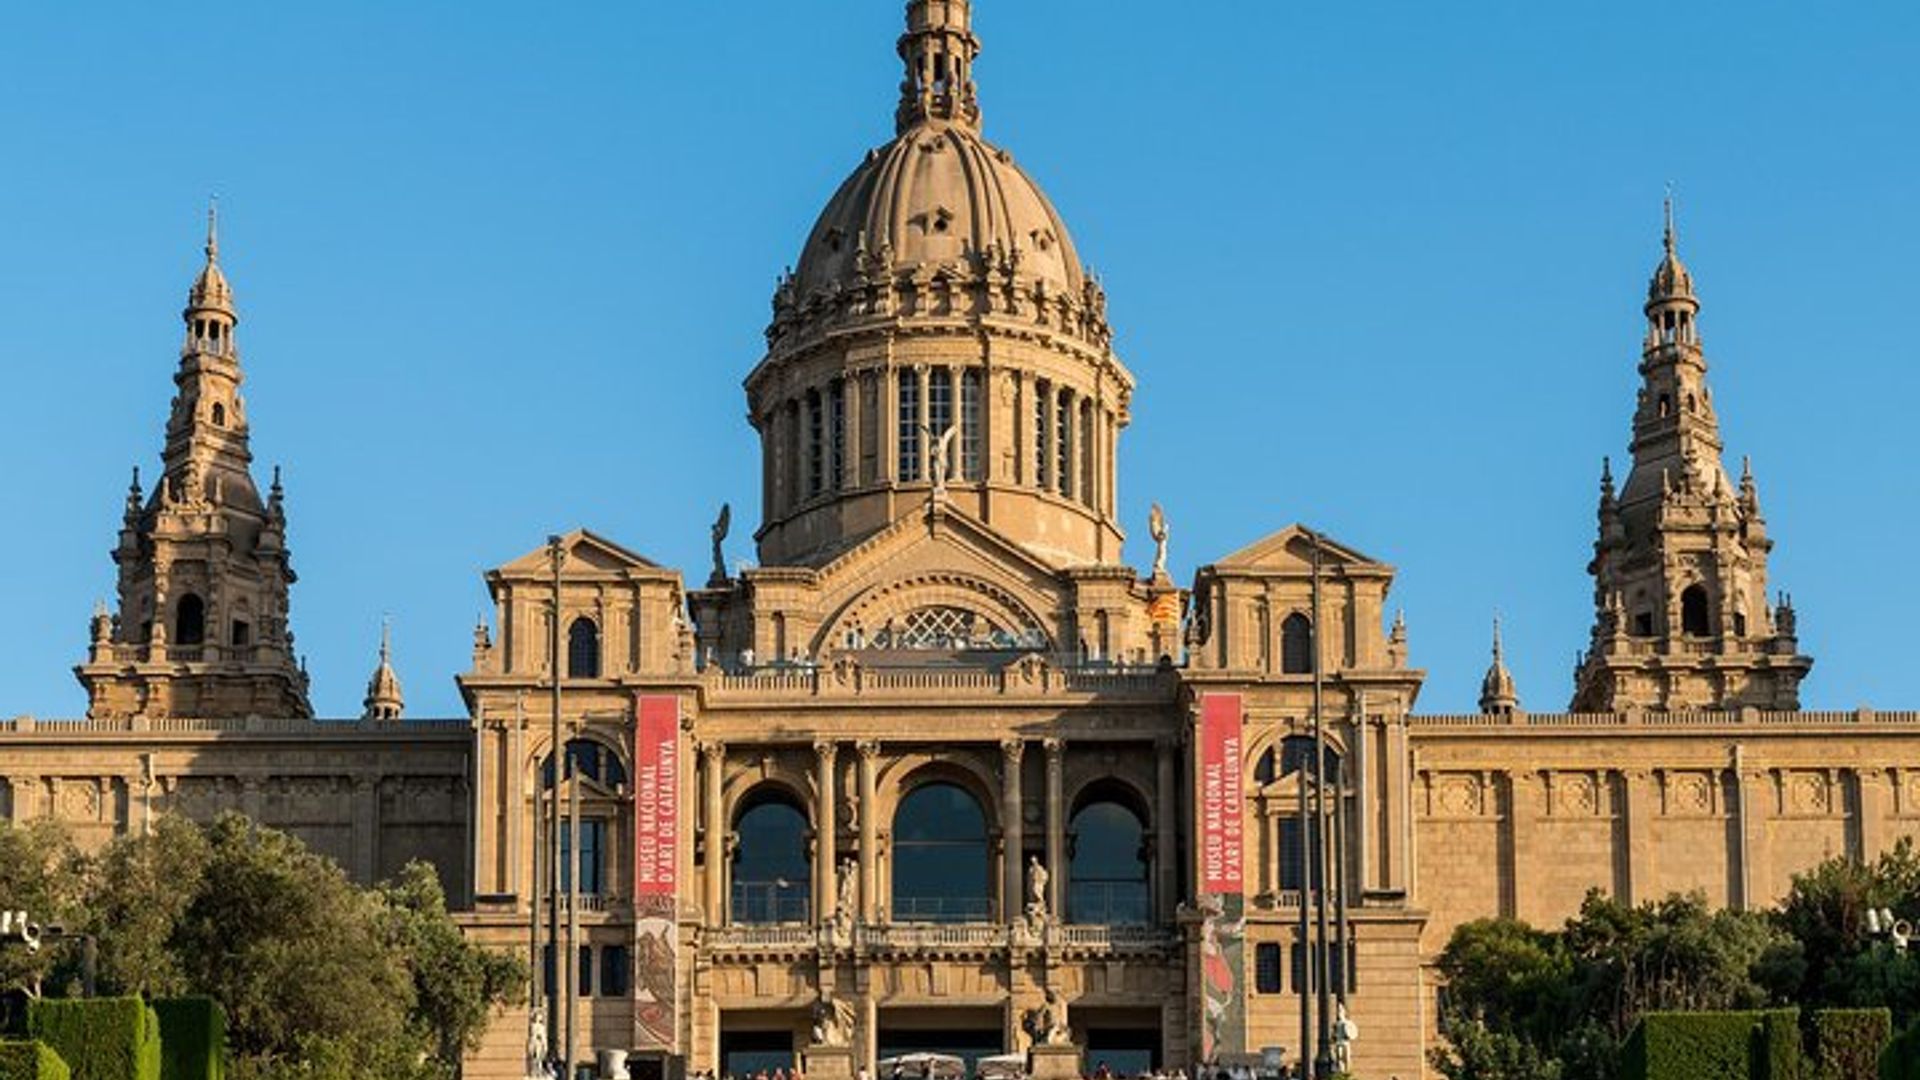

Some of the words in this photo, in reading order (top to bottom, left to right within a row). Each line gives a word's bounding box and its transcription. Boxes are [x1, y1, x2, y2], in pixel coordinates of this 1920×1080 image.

[640, 765, 656, 832] NACIONAL
[659, 739, 675, 816] CATALUNYA
[1205, 763, 1222, 830] NACIONAL
[1224, 737, 1239, 814] CATALUNYA
[659, 821, 674, 837] DE
[1224, 819, 1240, 837] DE
[640, 835, 656, 883] MUSEU
[659, 842, 674, 883] D'ART
[1206, 833, 1222, 881] MUSEU
[1224, 841, 1241, 881] D'ART
